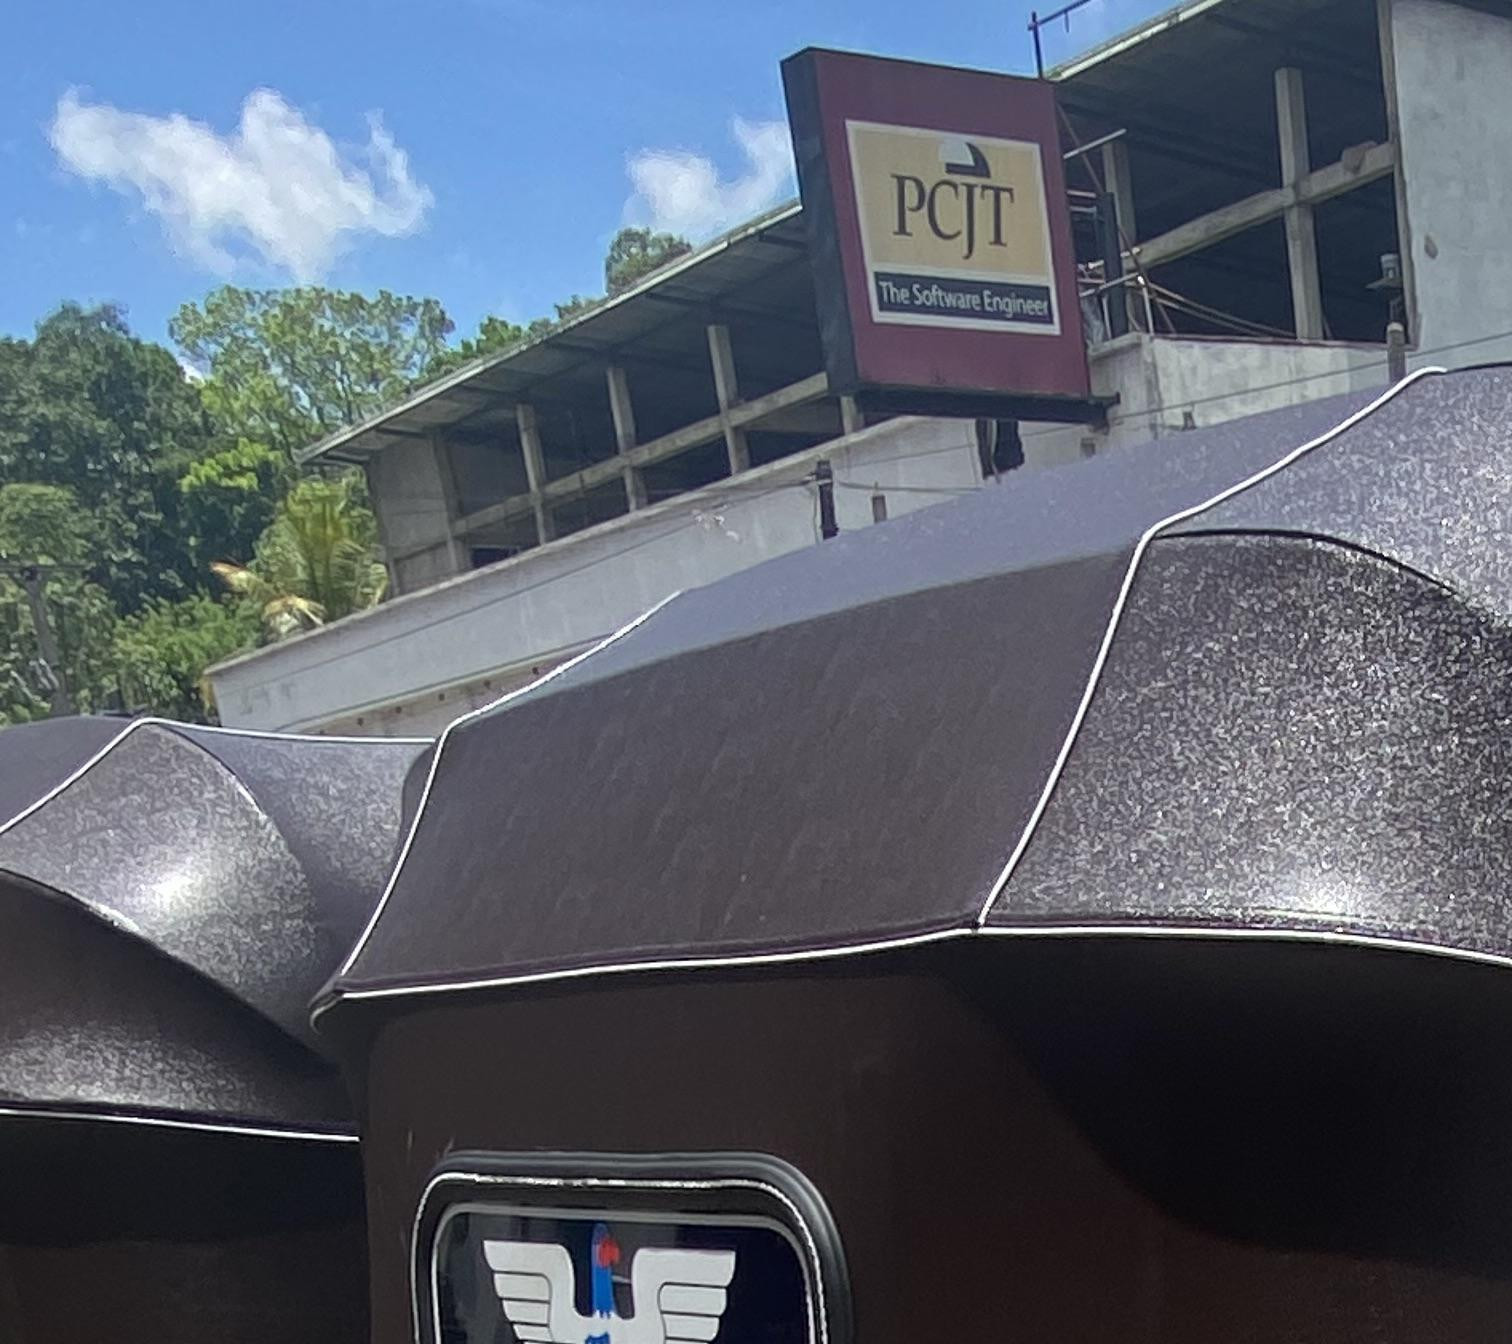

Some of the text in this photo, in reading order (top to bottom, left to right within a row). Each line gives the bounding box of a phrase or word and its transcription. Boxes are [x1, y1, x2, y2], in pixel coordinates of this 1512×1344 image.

[891, 174, 1014, 260] PCJT
[879, 281, 1049, 318] The Software Engineer
